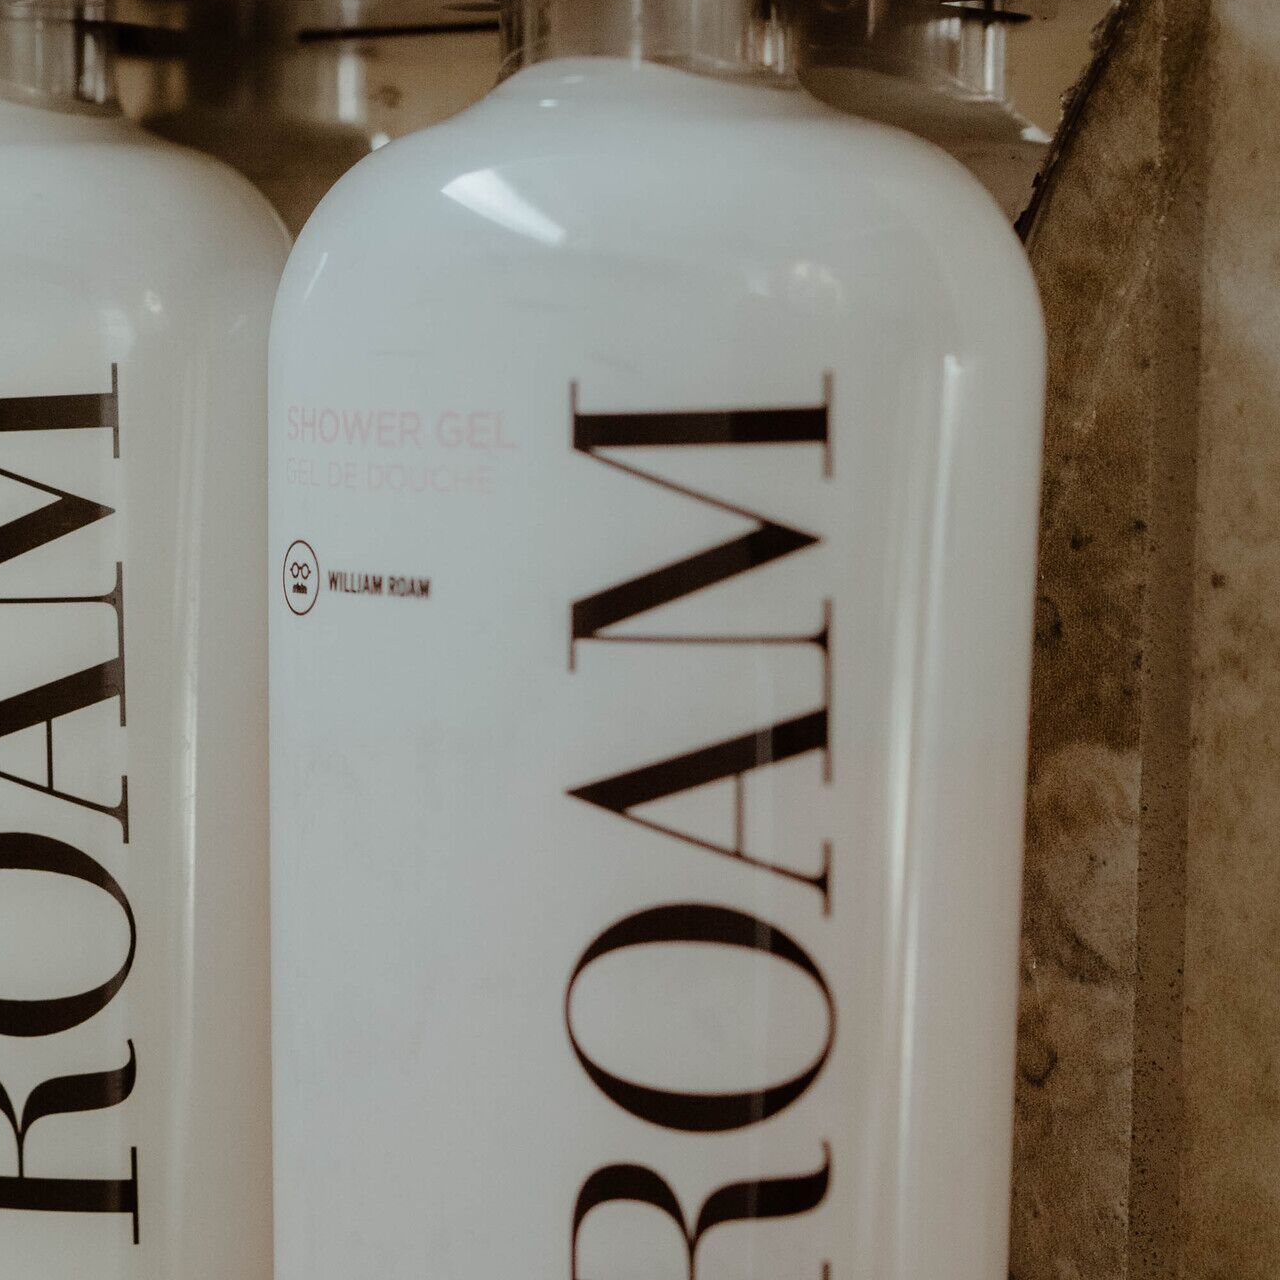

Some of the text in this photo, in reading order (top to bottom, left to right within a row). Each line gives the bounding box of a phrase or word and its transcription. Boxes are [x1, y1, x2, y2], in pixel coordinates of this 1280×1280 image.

[287, 406, 518, 450] SHOWER GEL
[328, 570, 430, 598] WILLIAM ROAM
